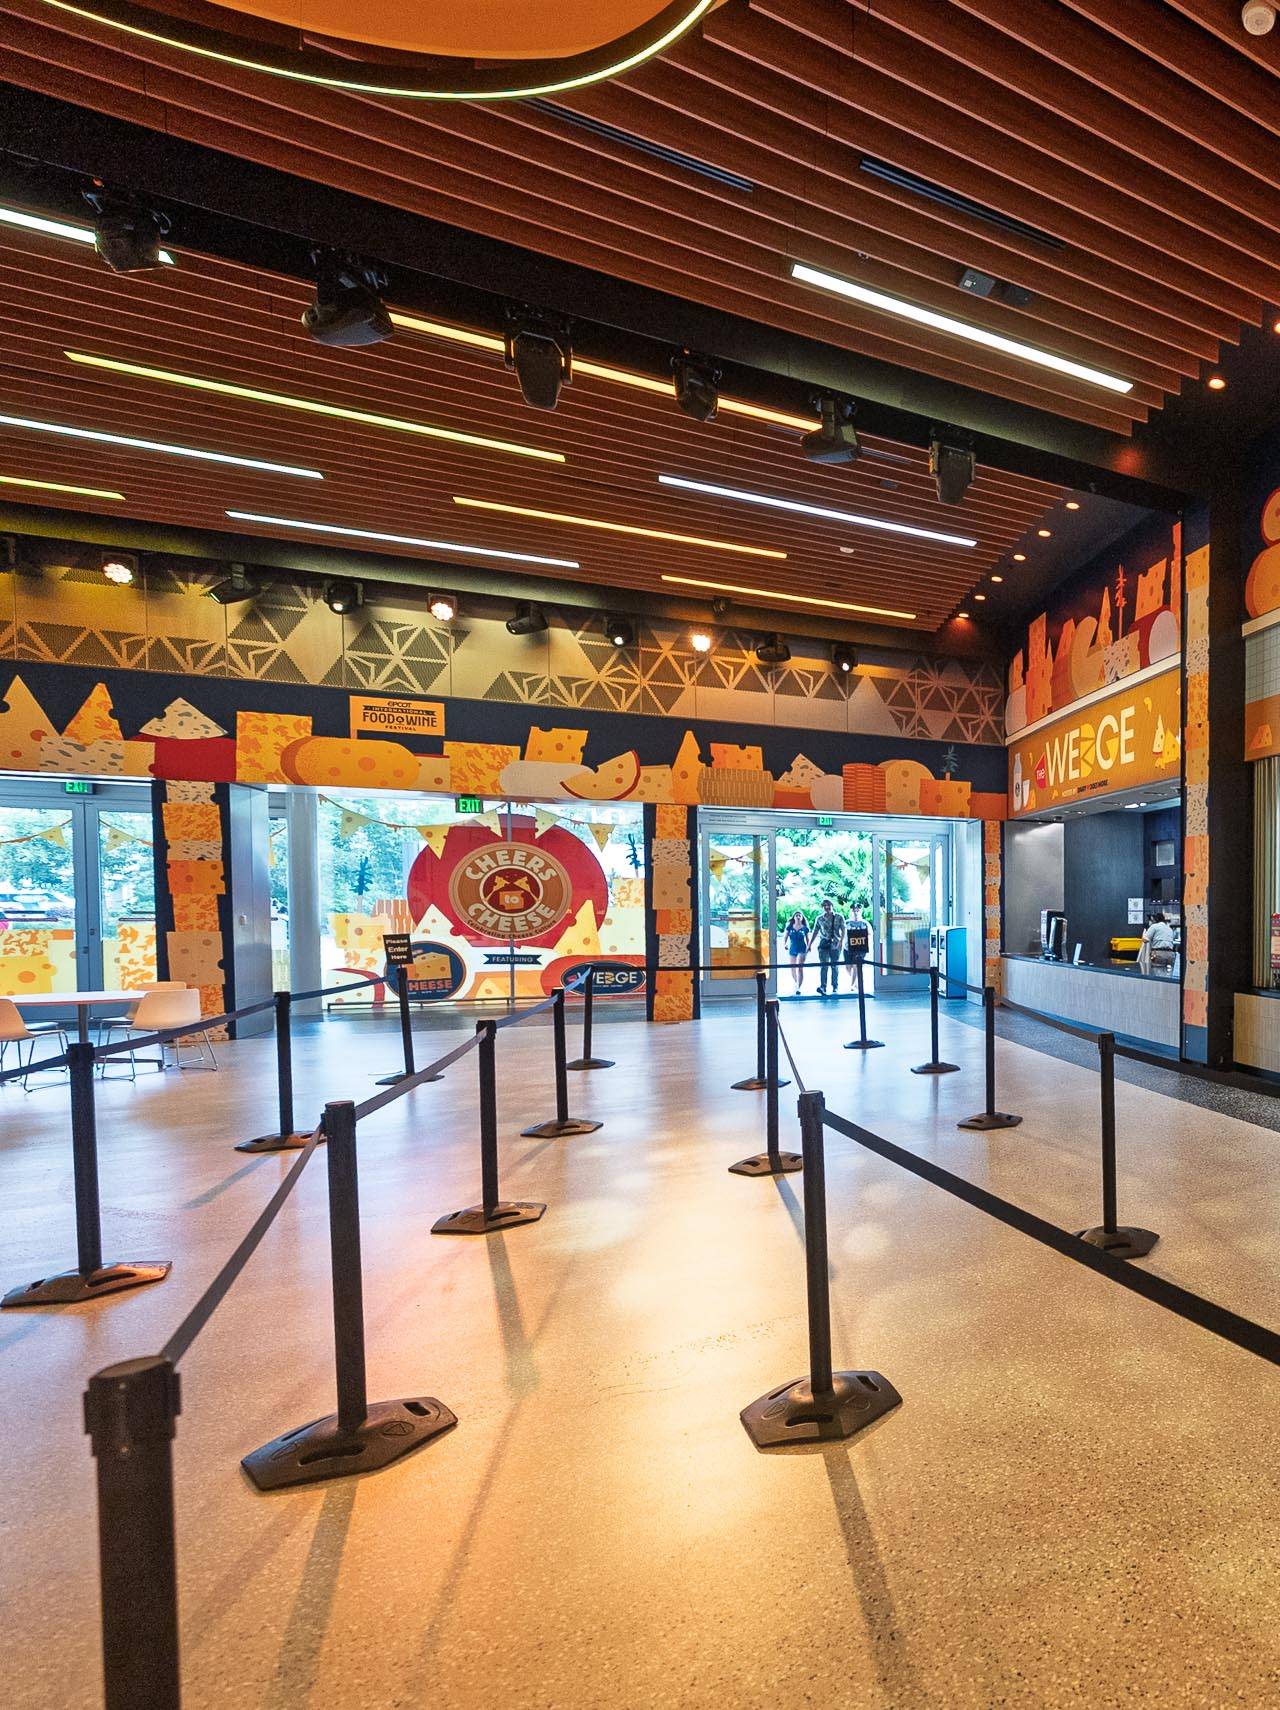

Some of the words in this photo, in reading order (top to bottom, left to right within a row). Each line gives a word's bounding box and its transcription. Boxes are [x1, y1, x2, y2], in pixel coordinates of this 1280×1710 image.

[371, 707, 427, 715] INTERNATIONAL
[362, 711, 395, 723] FOOD
[406, 715, 438, 727] WINE
[1045, 705, 1135, 786] WEDGE
[65, 781, 88, 793] EXIT
[460, 799, 480, 813] EXIT
[465, 849, 557, 881] CHEERS
[504, 895, 519, 904] to
[467, 903, 556, 932] CHEESE
[850, 937, 866, 945] EXIT
